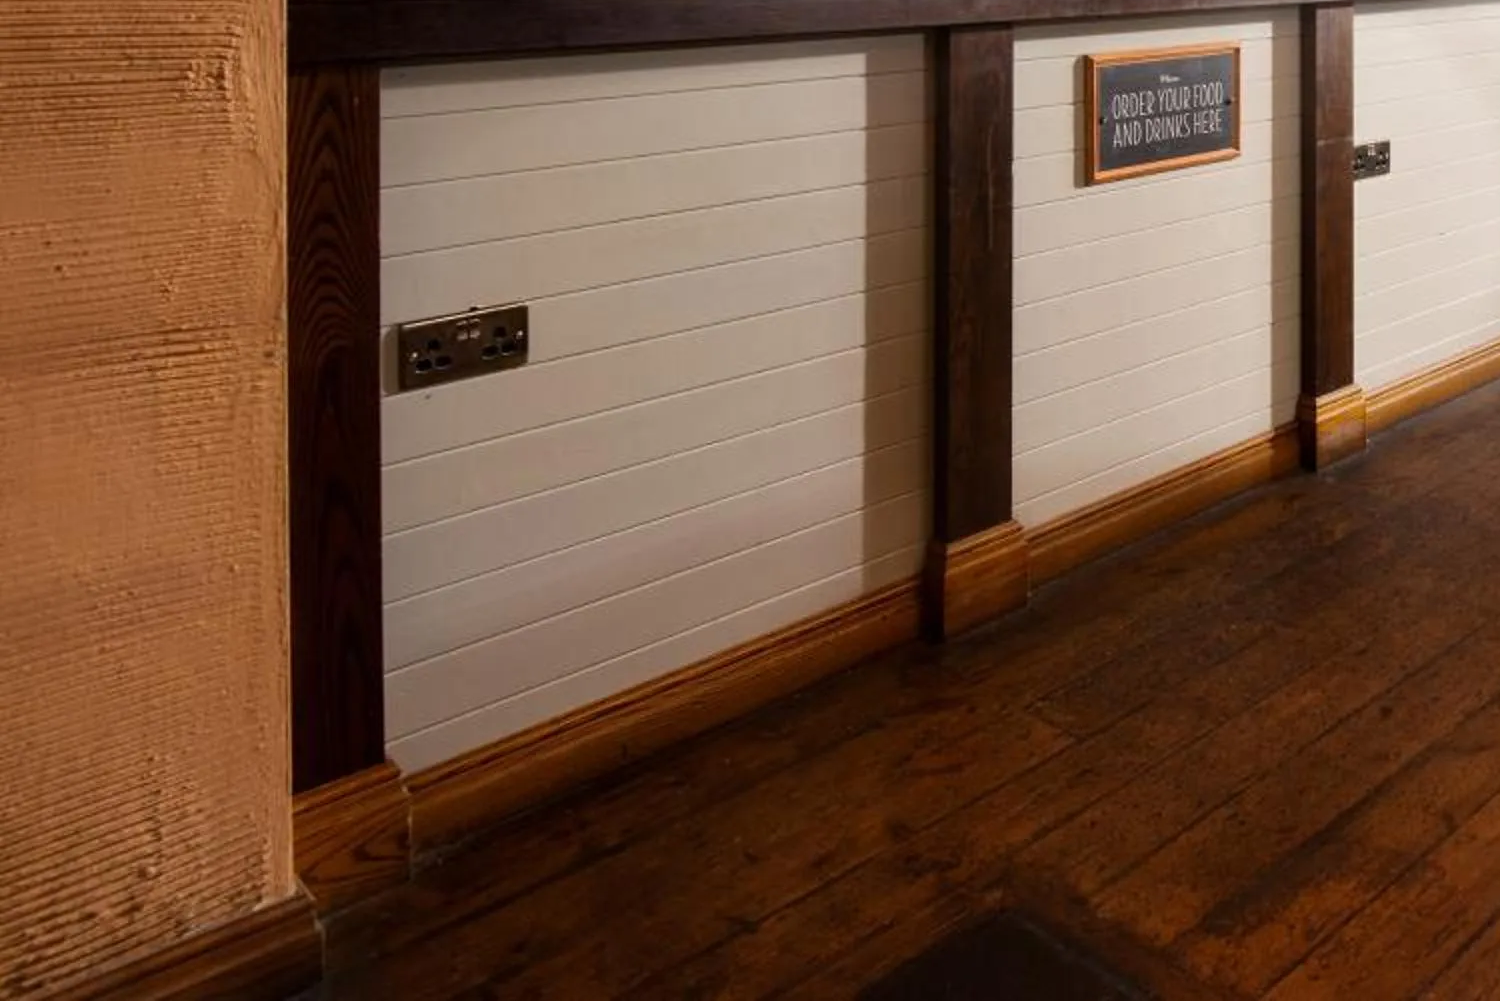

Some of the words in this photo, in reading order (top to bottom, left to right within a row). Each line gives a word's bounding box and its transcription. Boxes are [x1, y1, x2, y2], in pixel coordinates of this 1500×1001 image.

[1112, 90, 1155, 119] ORDER
[1157, 86, 1191, 113] YOUR
[1193, 81, 1223, 107] FOOD
[1112, 121, 1141, 148] AND
[1145, 113, 1191, 143] DRINKS
[1193, 108, 1223, 136] HERE
